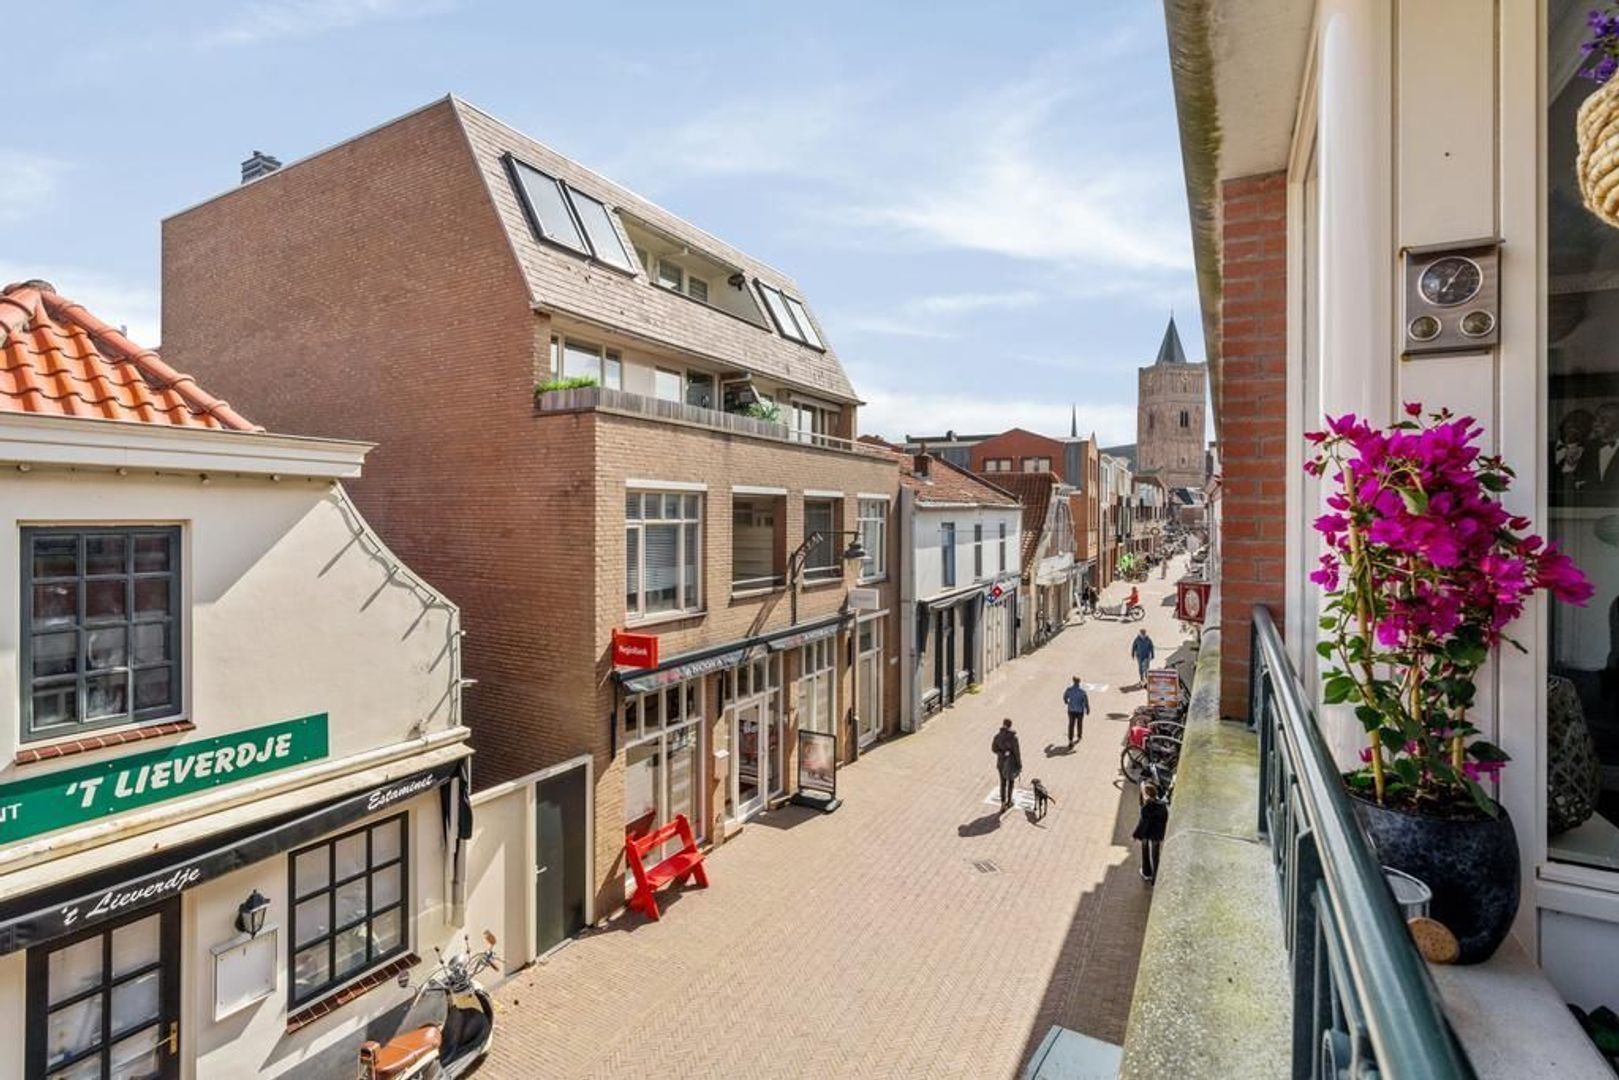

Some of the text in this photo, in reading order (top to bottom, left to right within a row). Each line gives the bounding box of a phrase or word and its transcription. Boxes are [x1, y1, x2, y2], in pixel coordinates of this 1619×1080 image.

[66, 776, 104, 807] 'T
[114, 733, 293, 798] LIEVERDJE
[367, 773, 434, 811] Estaminet
[85, 866, 202, 920] Lieverdje
